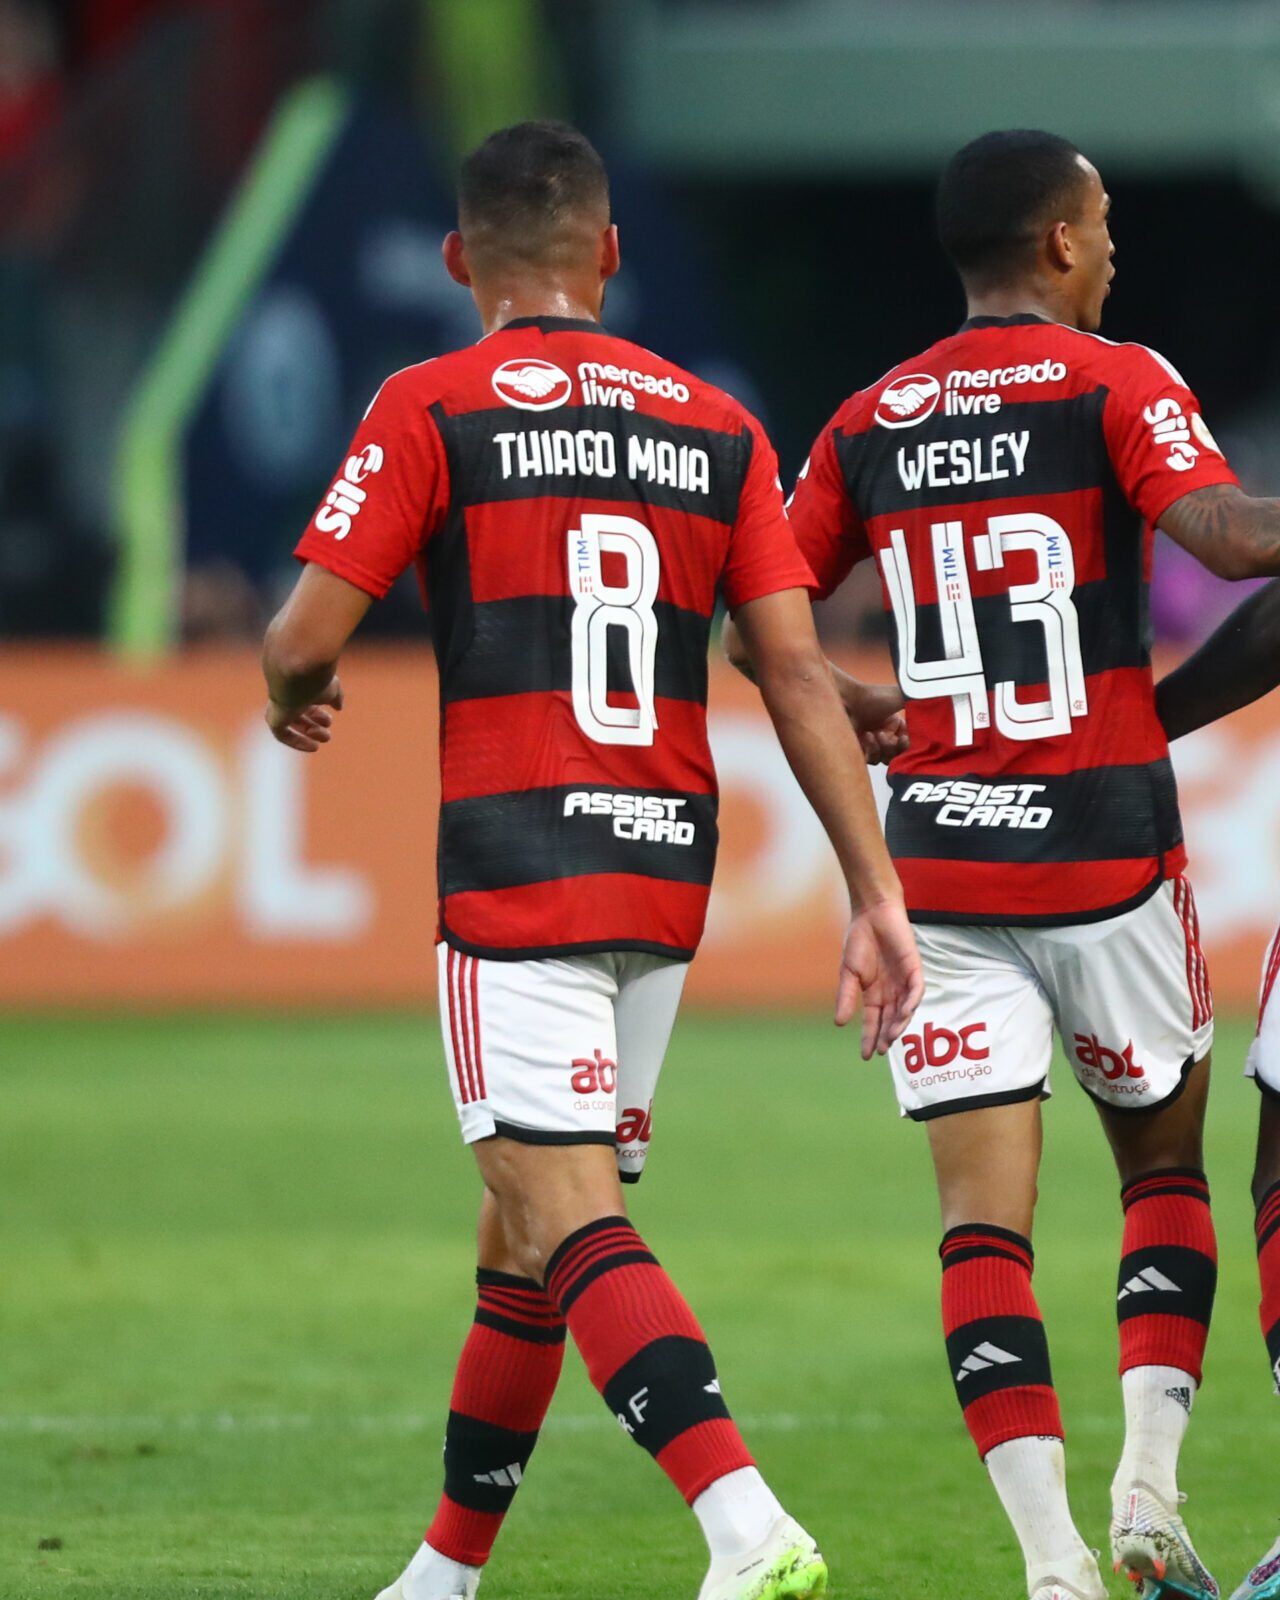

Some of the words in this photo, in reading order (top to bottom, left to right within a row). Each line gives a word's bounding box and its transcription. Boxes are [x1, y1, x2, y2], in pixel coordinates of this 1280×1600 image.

[578, 361, 690, 404] mercado
[945, 358, 1067, 389] mercado
[581, 378, 636, 412] livre
[945, 390, 1001, 417] livre
[494, 430, 616, 480] THIAGO
[628, 433, 710, 494] MAIA
[896, 430, 1030, 491] WESLEY
[576, 540, 591, 572] TIM
[944, 547, 958, 580] TIM
[1048, 535, 1061, 568] TIM
[567, 513, 660, 747] 8
[880, 512, 1089, 747] 43
[563, 791, 688, 820] ASSIST
[900, 780, 1047, 805] ASSIST
[0, 708, 377, 945] OL
[612, 816, 695, 846] CARD
[935, 805, 1054, 830] CARD
[901, 1022, 990, 1074] abc
[571, 1048, 617, 1095] ab
[920, 1063, 993, 1088] construção
